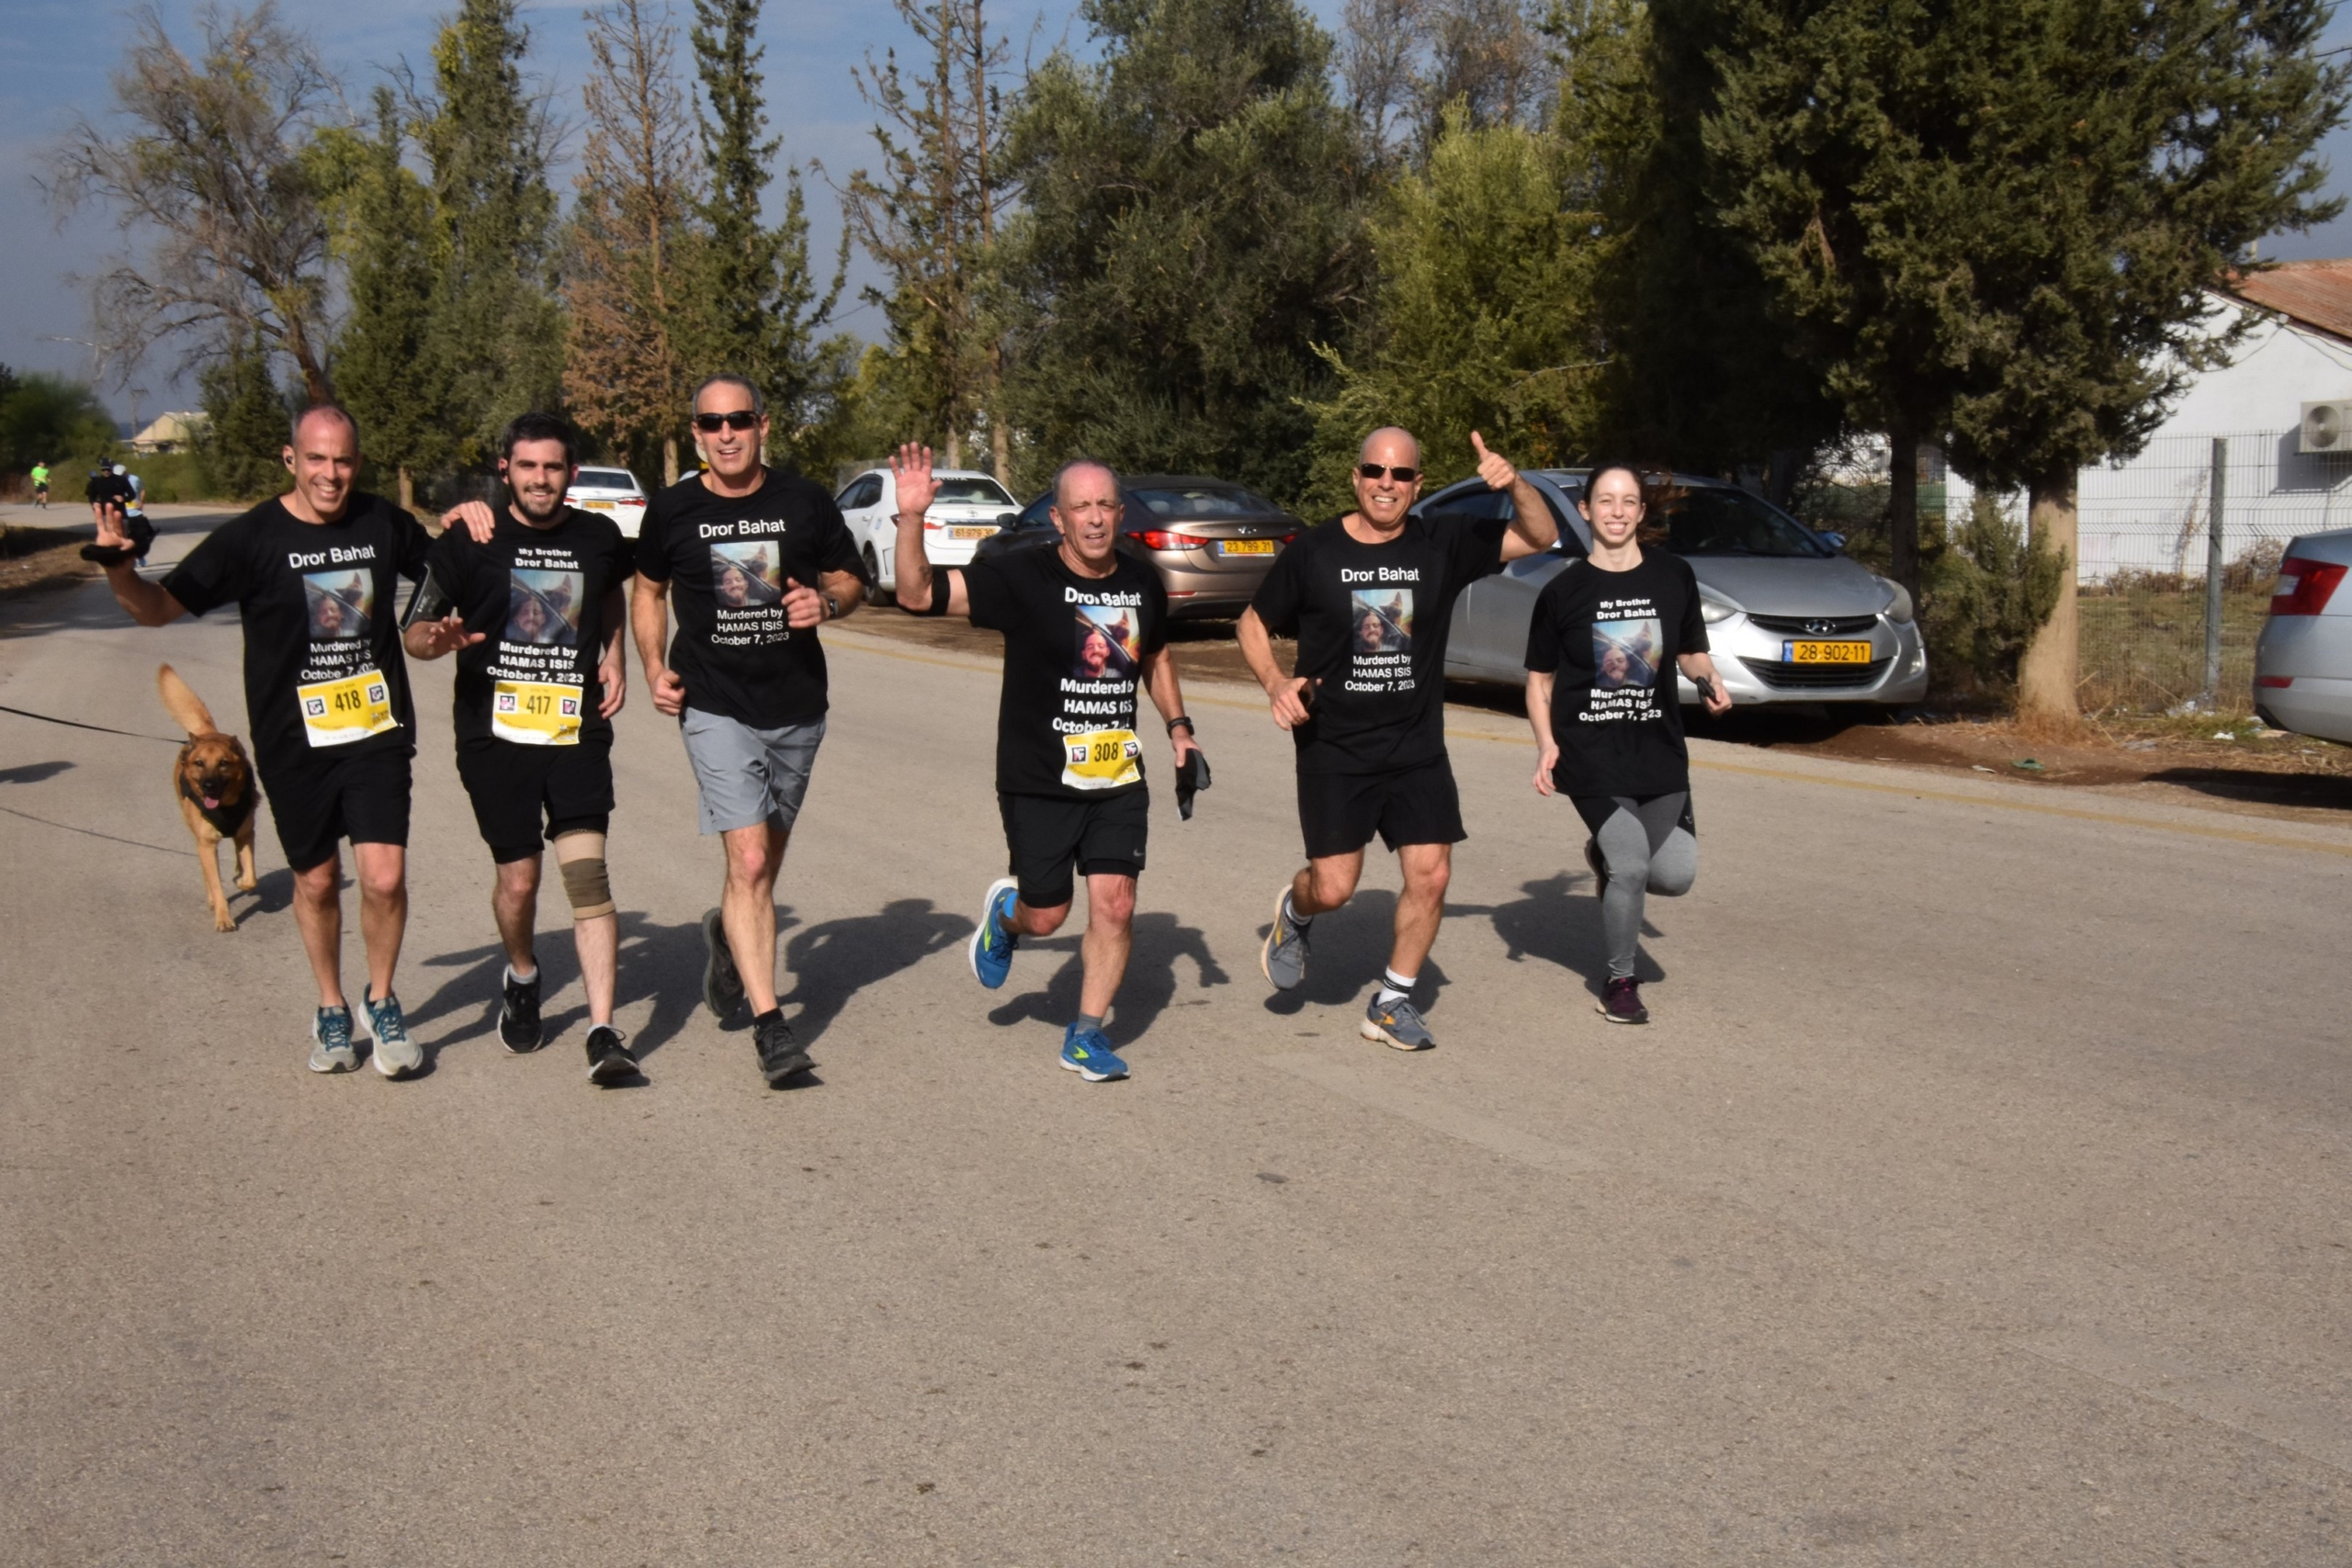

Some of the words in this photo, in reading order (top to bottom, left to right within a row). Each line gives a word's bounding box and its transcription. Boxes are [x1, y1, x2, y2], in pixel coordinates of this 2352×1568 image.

[699, 523, 734, 538] Dror
[738, 518, 786, 535] Bahat
[288, 552, 326, 569] Dror
[330, 544, 376, 563] Bahat
[518, 547, 533, 557] My
[535, 547, 572, 557] Brother
[514, 558, 541, 568] Dror
[544, 558, 579, 570] Bahat
[1341, 569, 1374, 582] Dror
[1378, 567, 1419, 581] Bahat
[1101, 590, 1142, 606] Bahat
[1600, 601, 1613, 609] My
[1615, 598, 1651, 607] Brother
[717, 608, 767, 620] Murdered
[770, 607, 784, 619] by
[1597, 611, 1622, 619] Dror
[1623, 607, 1657, 617] Bahat
[717, 621, 759, 633] HAMAS
[762, 620, 784, 631] ISIS
[310, 639, 361, 653] Murdered
[711, 634, 751, 646] October
[753, 634, 763, 645] 7,
[766, 632, 789, 644] 2023
[499, 641, 559, 656] Murdered
[562, 647, 578, 660] by
[310, 653, 353, 666] HAMAS
[500, 655, 546, 669] HAMAS
[549, 659, 575, 670] ISIS
[1352, 654, 1399, 666] Murdered
[1401, 654, 1411, 665] by
[486, 666, 537, 681] October
[540, 671, 553, 683] 7,
[1352, 667, 1392, 678] HAMAS
[1395, 666, 1412, 678] ISIS
[1060, 678, 1126, 694] Murdered
[1344, 680, 1385, 692] October
[1386, 681, 1396, 693] 7,
[334, 690, 362, 712] 418
[526, 695, 551, 715] 417
[1064, 698, 1117, 715] HAMAS
[1590, 698, 1633, 710] HAMAS
[1578, 710, 1625, 722] October
[1094, 741, 1119, 762] 308
